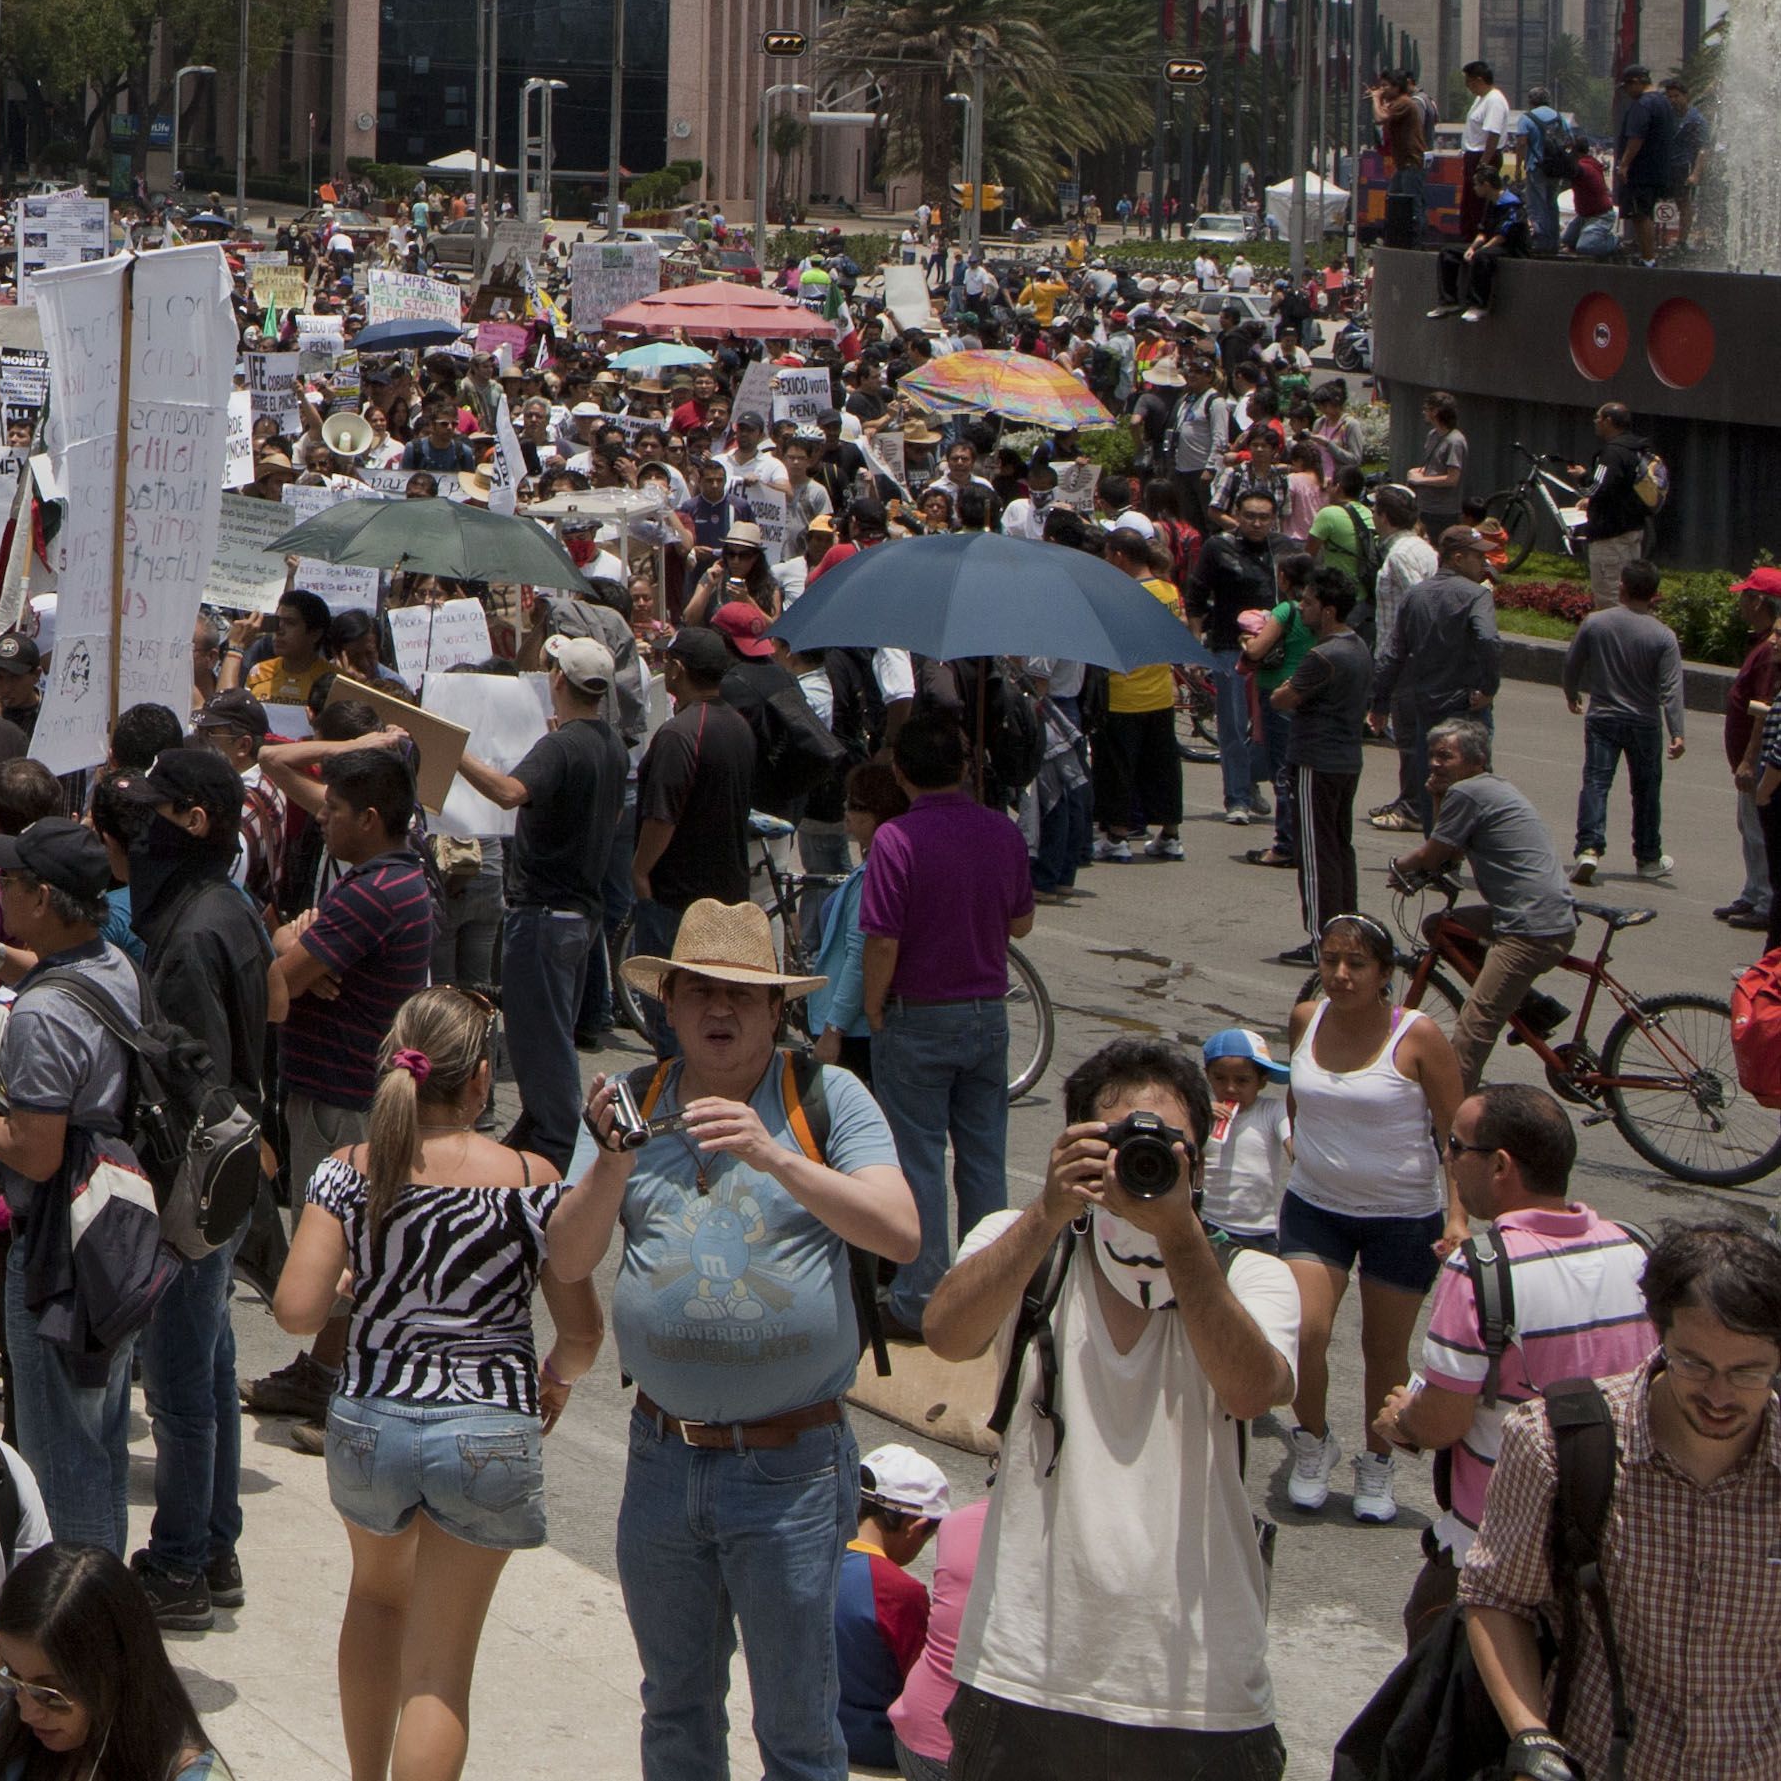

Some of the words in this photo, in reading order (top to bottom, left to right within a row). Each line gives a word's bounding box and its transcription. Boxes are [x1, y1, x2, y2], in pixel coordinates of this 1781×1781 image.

[370, 271, 387, 285] LA
[391, 272, 460, 297] IMPOSICION
[310, 337, 332, 352] PEÑA
[1, 355, 44, 367] MONEY
[249, 354, 267, 389] IFE
[789, 399, 819, 419] PEÑA
[662, 1321, 758, 1342] POWERED
[760, 1321, 786, 1340] BY
